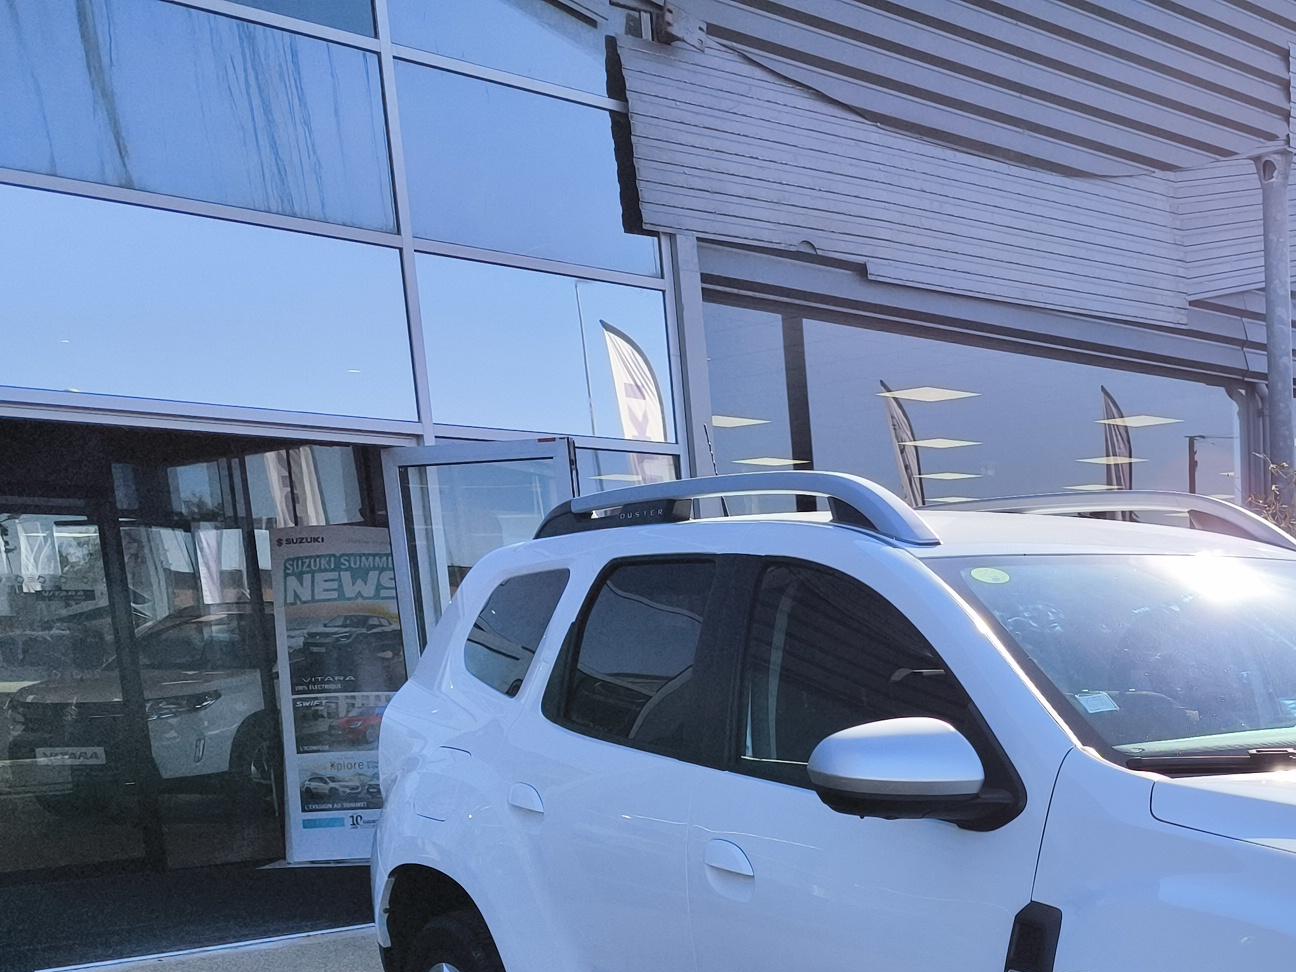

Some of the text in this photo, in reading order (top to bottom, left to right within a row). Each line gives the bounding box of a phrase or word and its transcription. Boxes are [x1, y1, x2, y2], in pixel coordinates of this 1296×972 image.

[619, 508, 664, 520] DUSTER
[284, 536, 325, 546] SUZUKI
[285, 556, 335, 574] SUZUKI
[286, 570, 397, 603] NEWS
[301, 675, 356, 683] VITARA
[295, 699, 329, 708] SWIFT
[350, 814, 363, 826] 10
